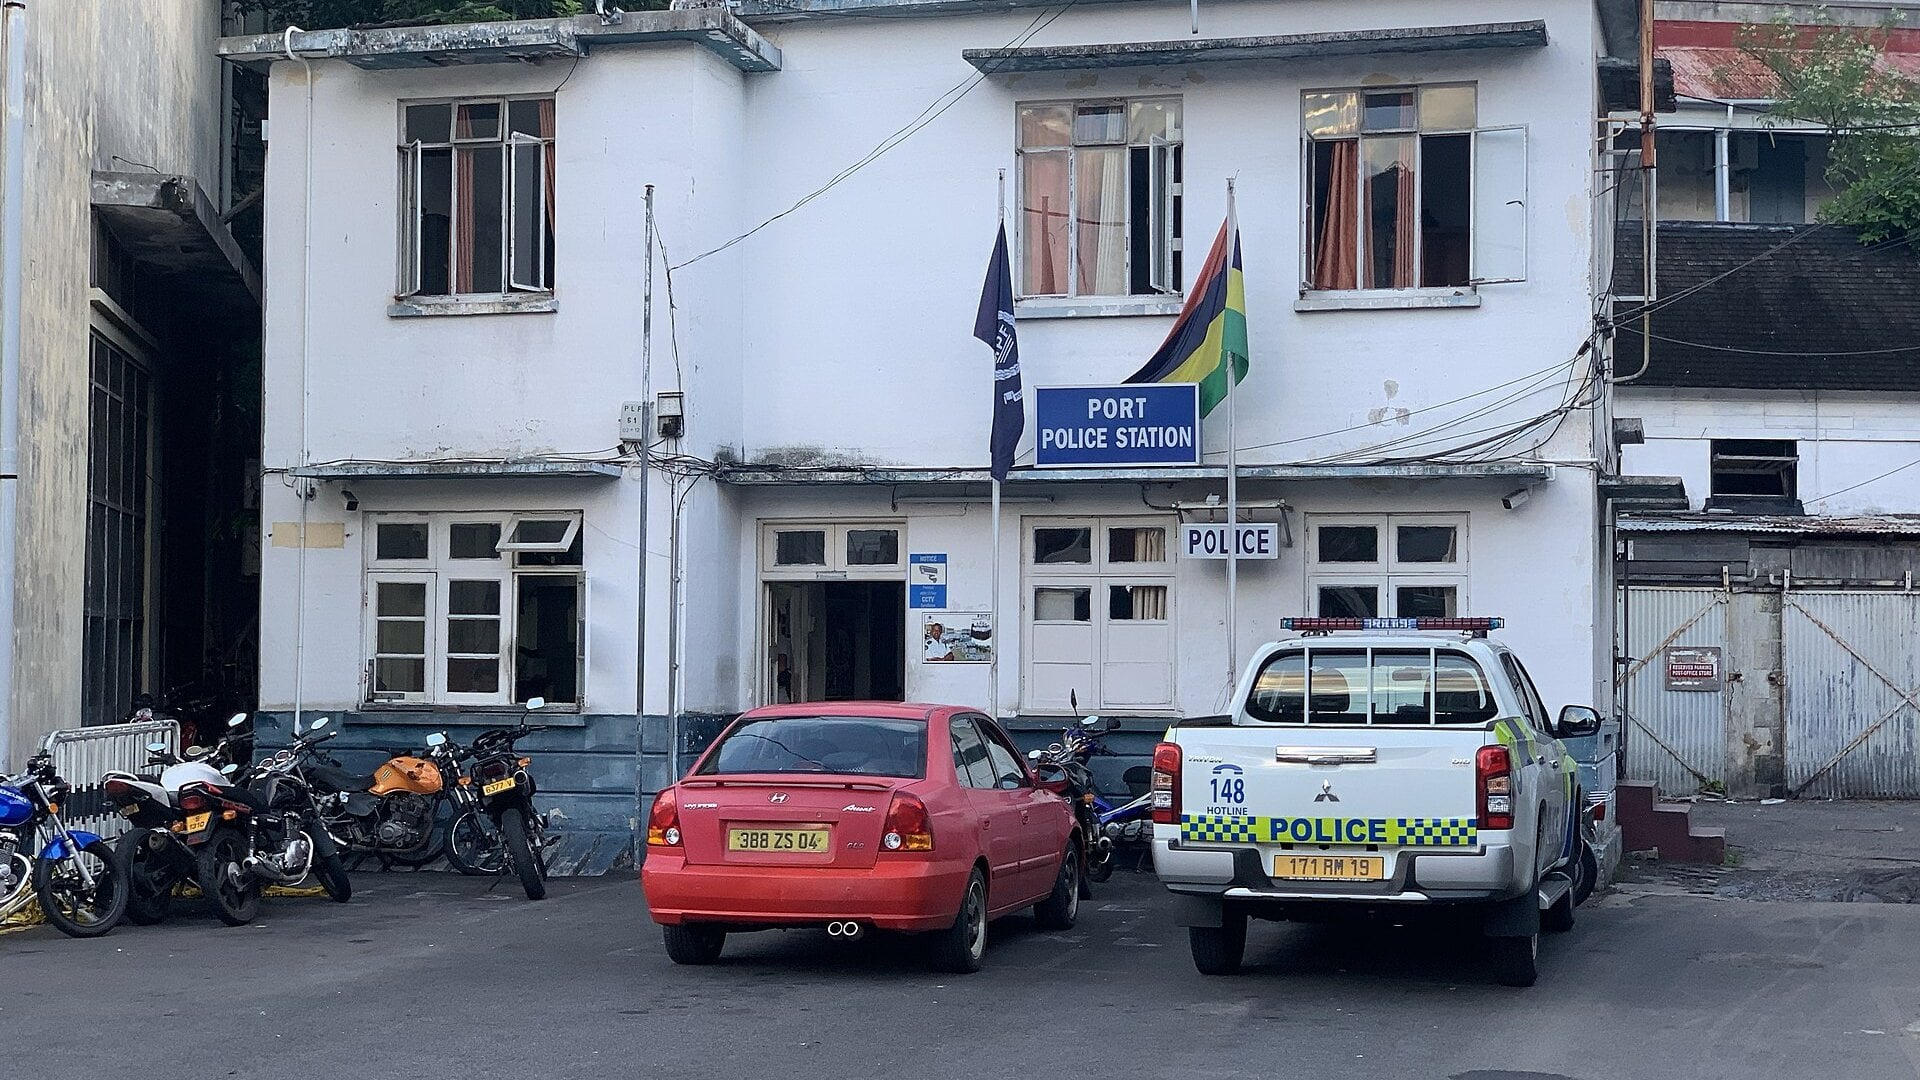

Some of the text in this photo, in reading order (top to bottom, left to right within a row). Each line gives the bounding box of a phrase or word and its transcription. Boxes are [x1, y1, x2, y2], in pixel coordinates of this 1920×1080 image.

[1087, 398, 1147, 420] PORT
[1041, 426, 1192, 450] POLICE STATION
[1189, 529, 1269, 555] POLICE
[1210, 778, 1245, 804] 148
[1207, 806, 1248, 816] HOTLINE
[740, 832, 818, 849] 388 ZS 04
[1270, 818, 1386, 842] POLICE
[1289, 858, 1368, 876] 171 RM 19
